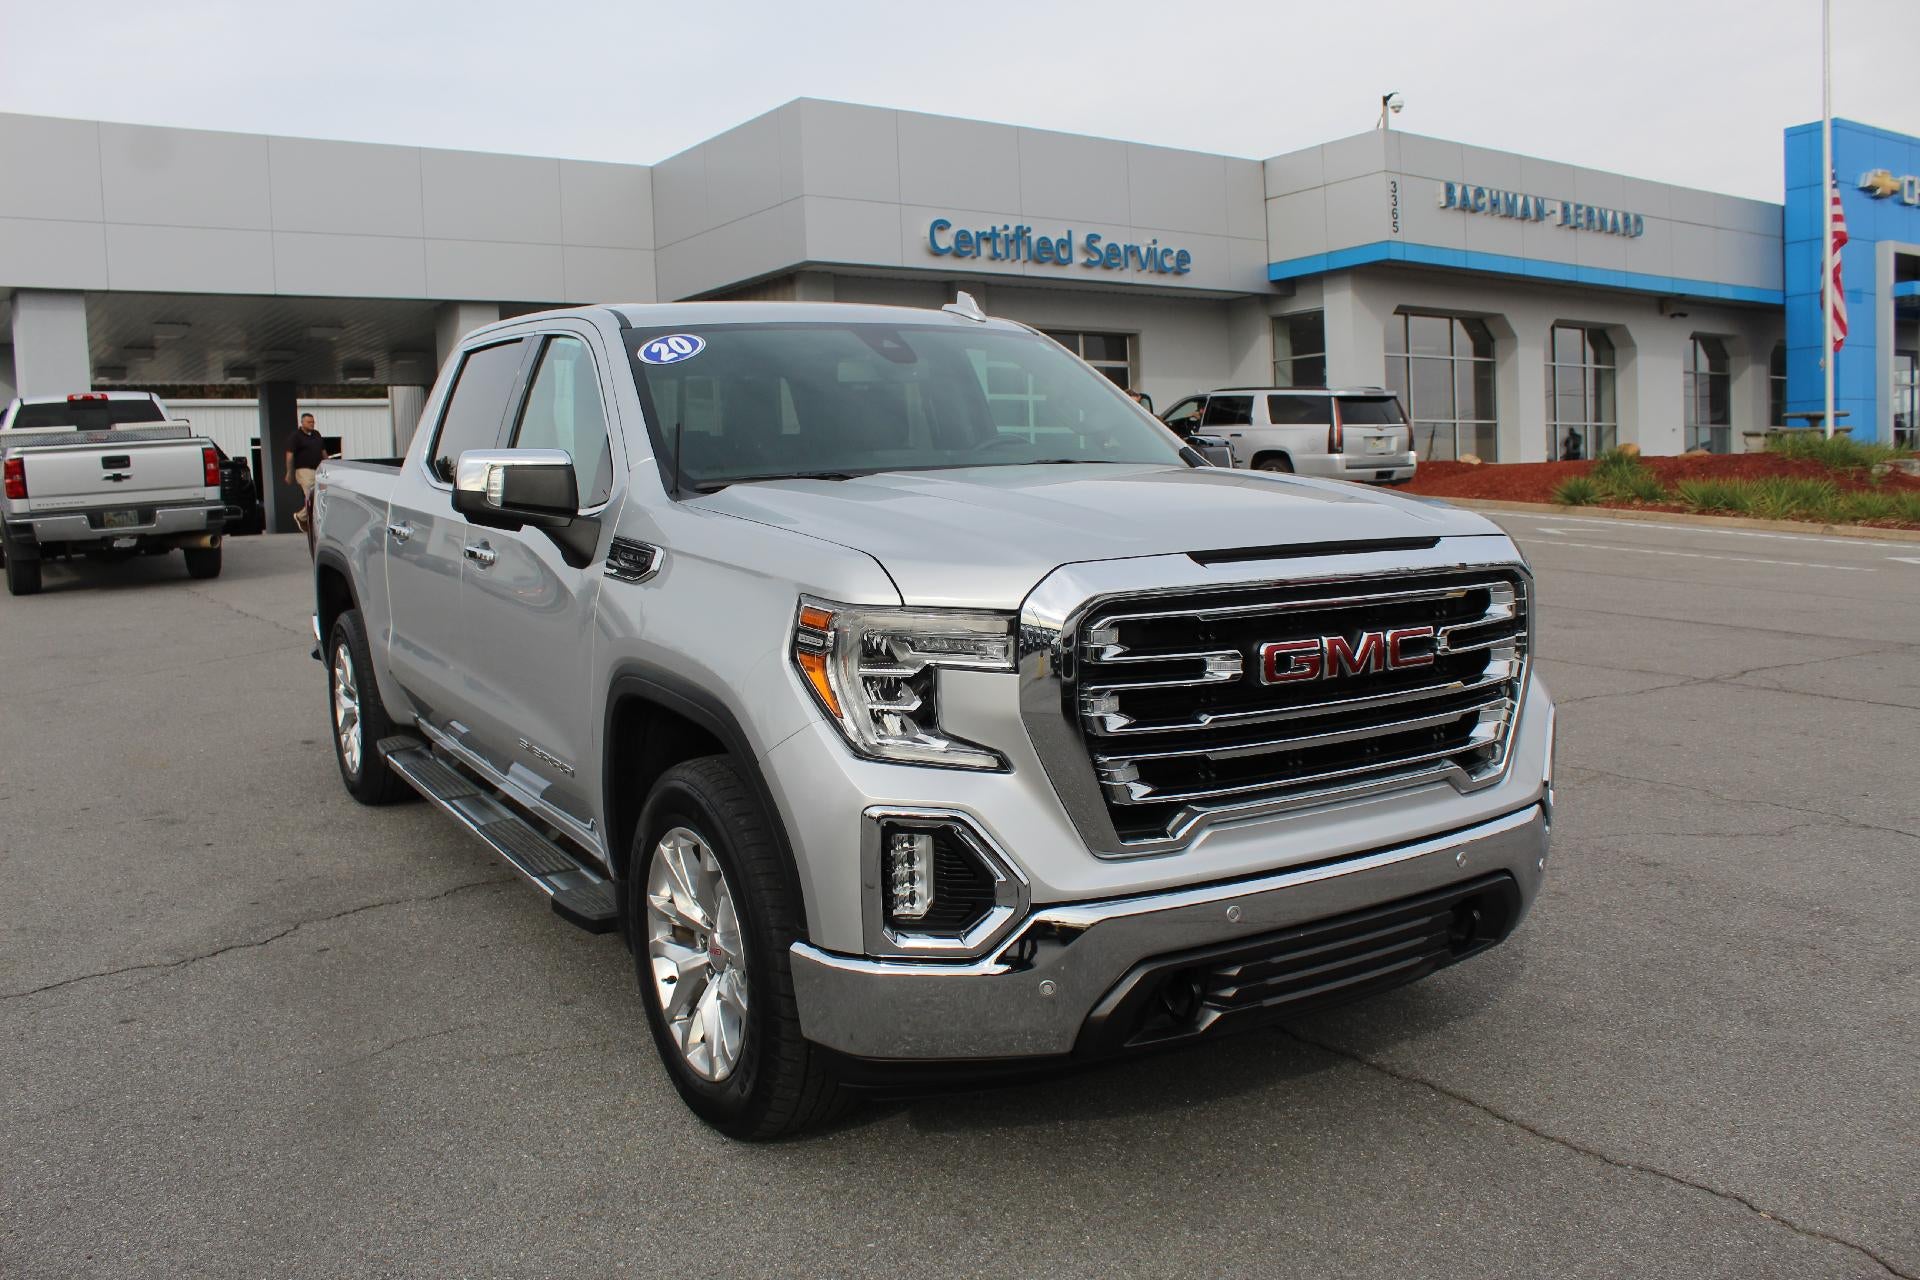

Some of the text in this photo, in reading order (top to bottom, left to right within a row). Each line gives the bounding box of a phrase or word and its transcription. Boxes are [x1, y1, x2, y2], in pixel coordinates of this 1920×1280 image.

[1390, 180, 1399, 234] 3365
[1440, 180, 1645, 239] BACHMAN-BERNARD
[928, 218, 1192, 275] Certified Service
[650, 336, 693, 362] 20
[1259, 625, 1434, 686] GMC
